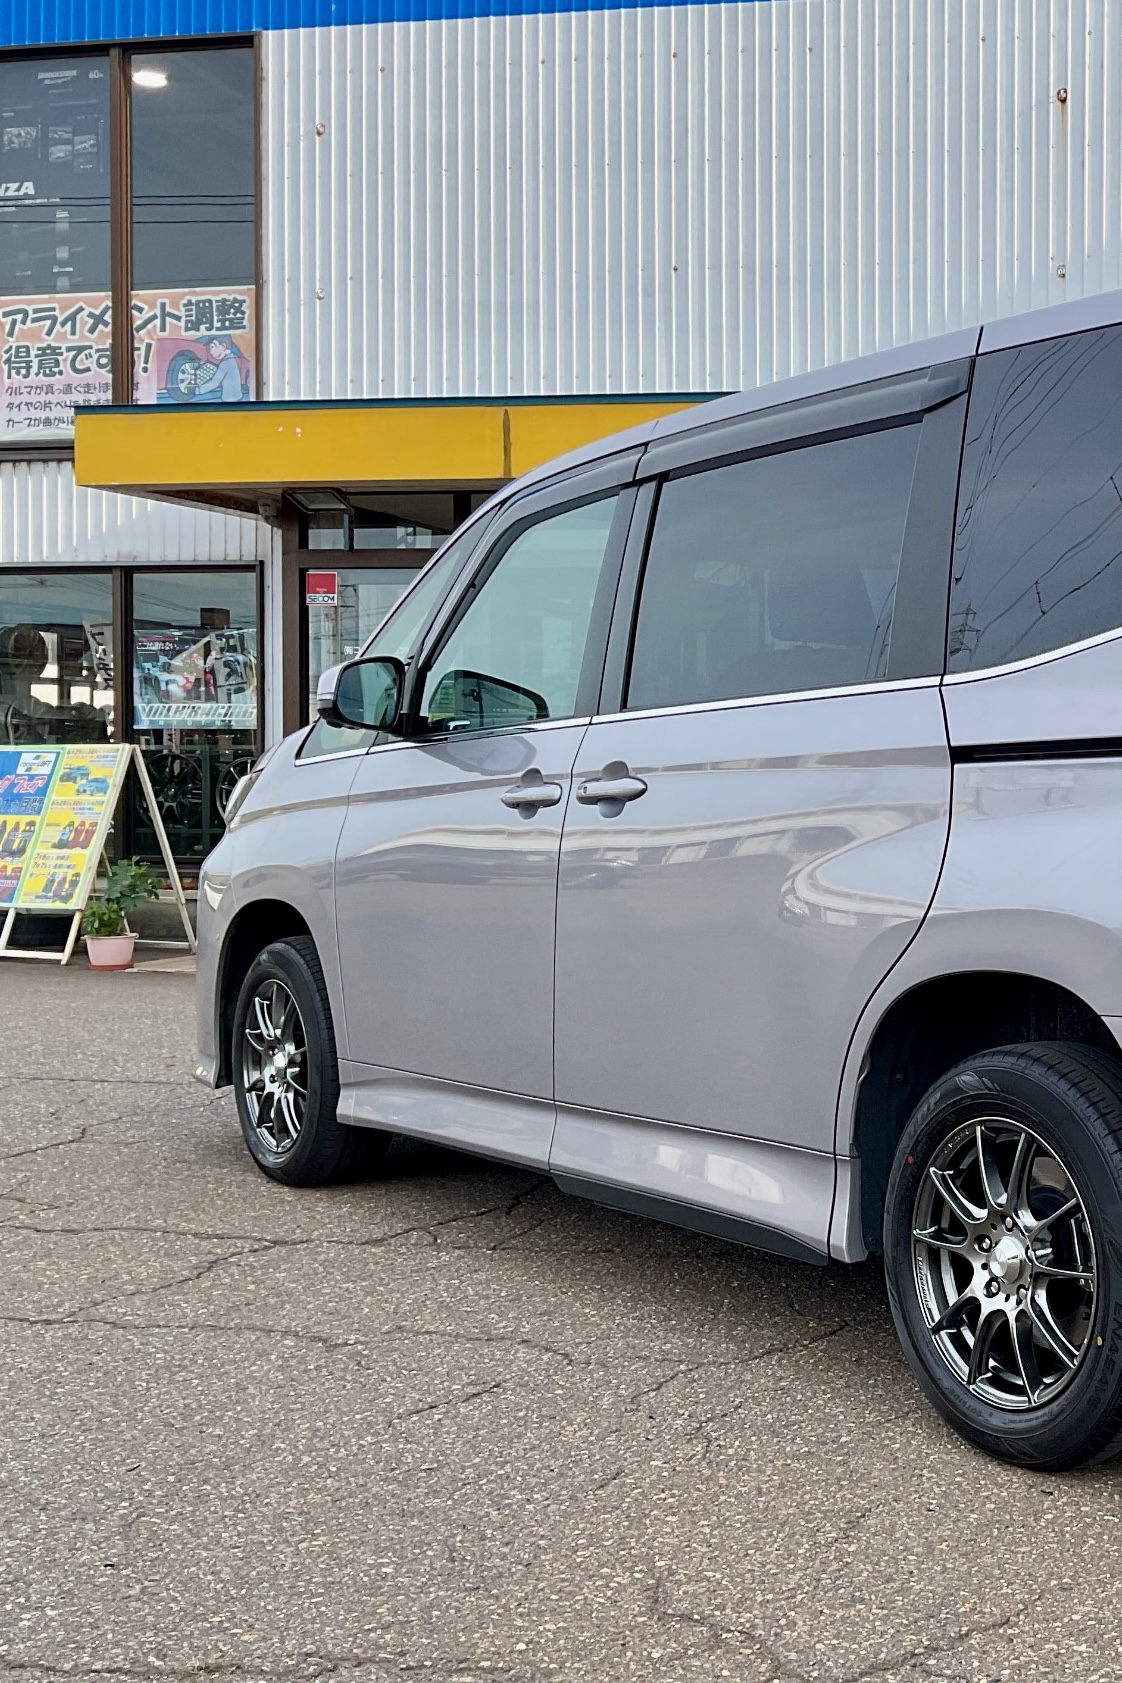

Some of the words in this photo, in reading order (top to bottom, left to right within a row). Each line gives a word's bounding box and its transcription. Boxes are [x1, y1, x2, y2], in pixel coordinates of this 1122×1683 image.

[2, 297, 247, 338] アライメント調整
[308, 595, 335, 603] SECOM
